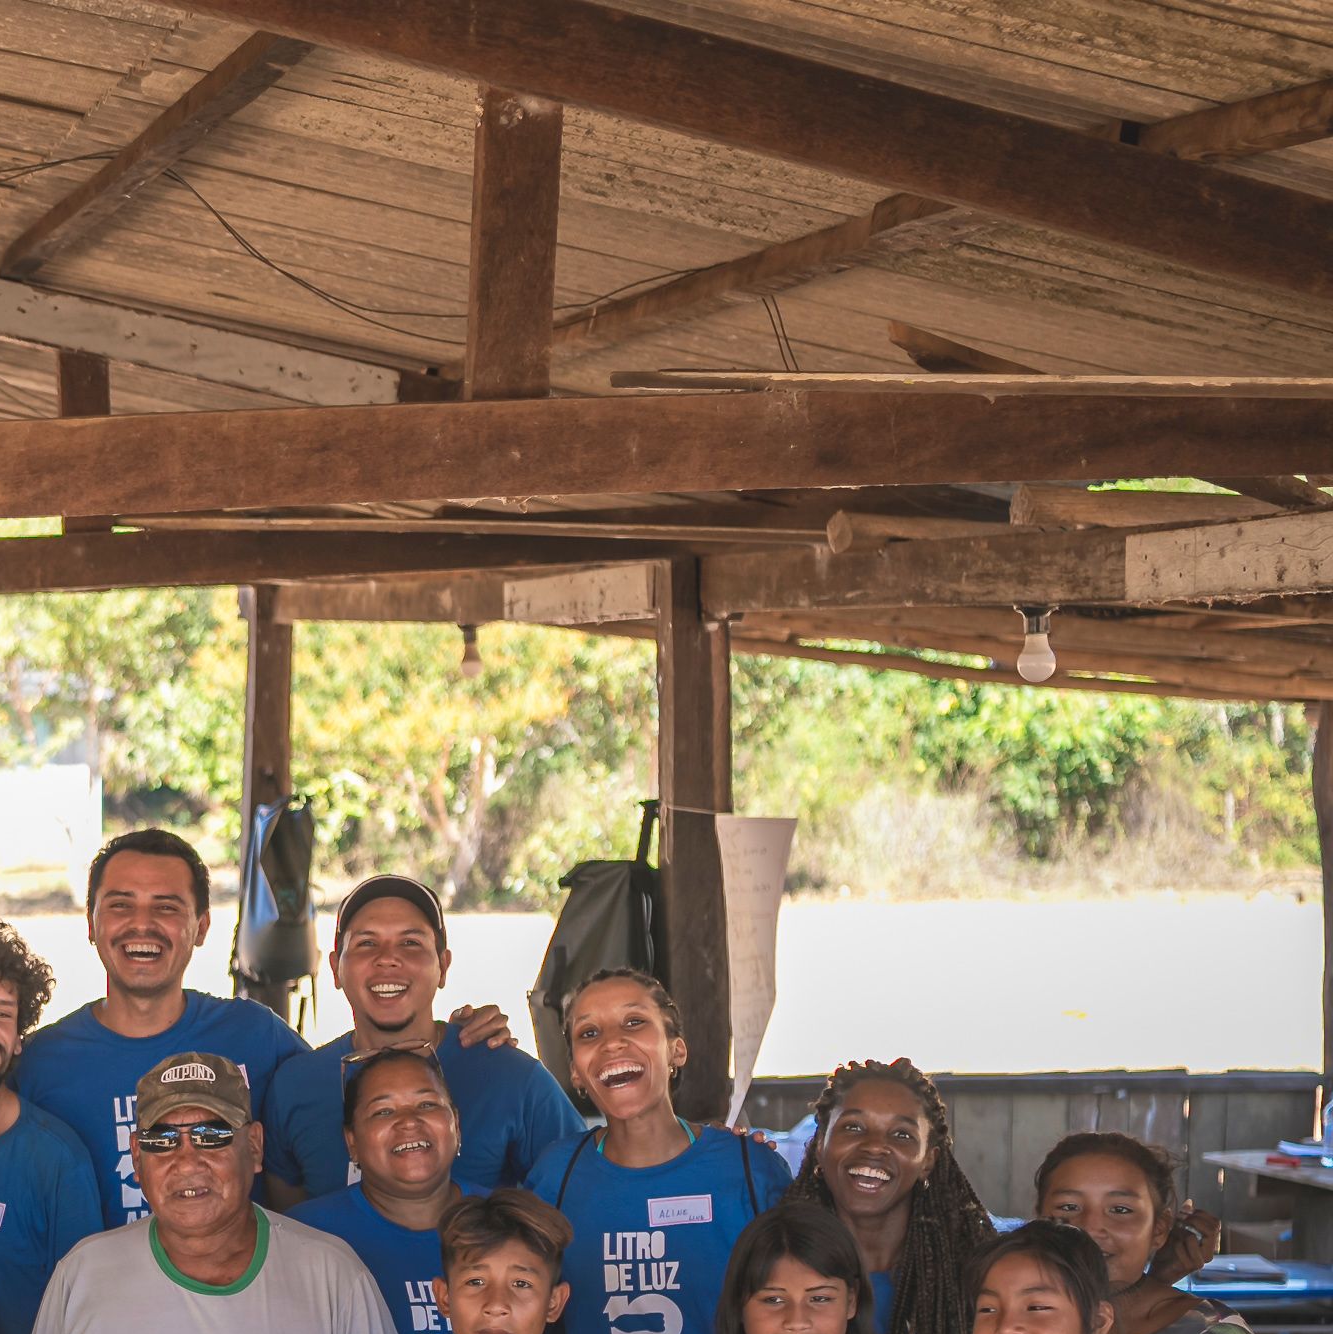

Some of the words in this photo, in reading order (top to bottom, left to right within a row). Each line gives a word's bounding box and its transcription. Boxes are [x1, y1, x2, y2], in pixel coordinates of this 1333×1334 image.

[659, 1208, 688, 1219] ALINE
[603, 1231, 666, 1260] LITRO
[604, 1264, 633, 1292] DE
[638, 1261, 680, 1290] LUZ
[405, 1281, 437, 1303] LIT
[410, 1305, 441, 1331] DE
